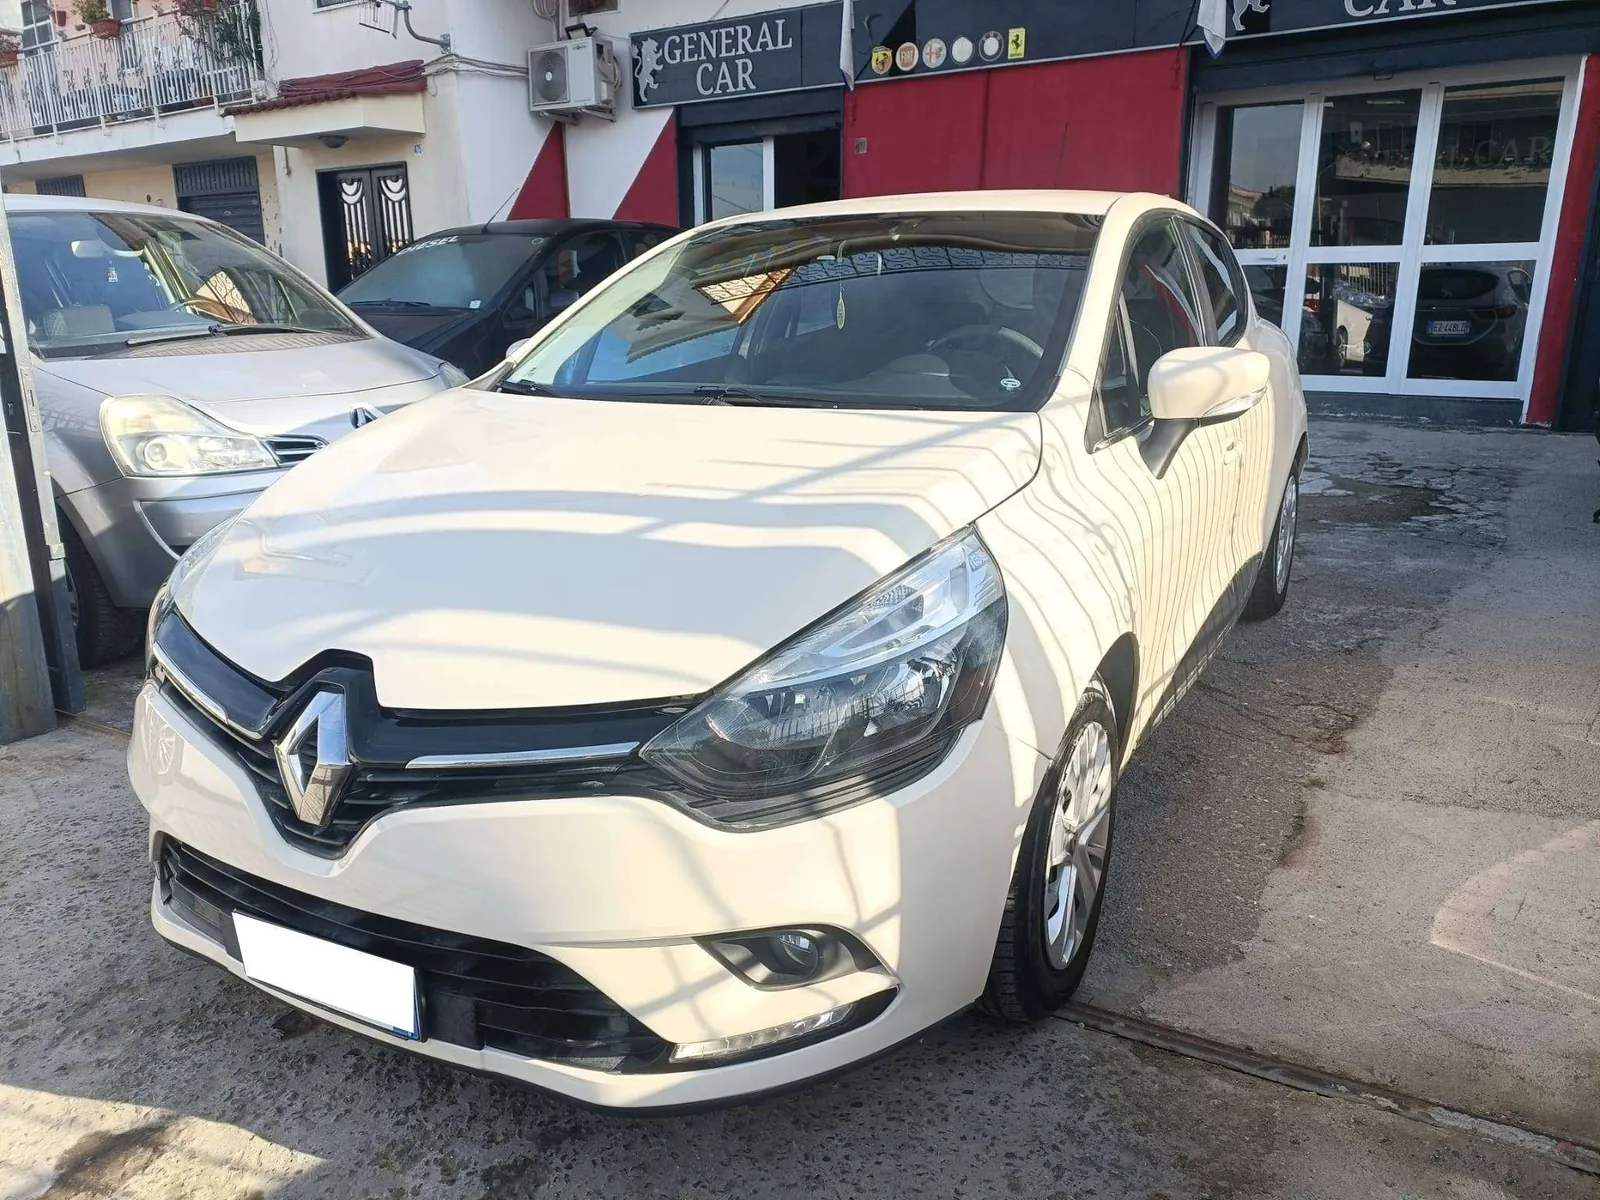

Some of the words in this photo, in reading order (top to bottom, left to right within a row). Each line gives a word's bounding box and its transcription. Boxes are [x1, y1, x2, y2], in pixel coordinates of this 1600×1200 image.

[664, 19, 793, 65] GENERAL
[696, 58, 756, 96] CAR
[395, 235, 459, 257] DIESEL
